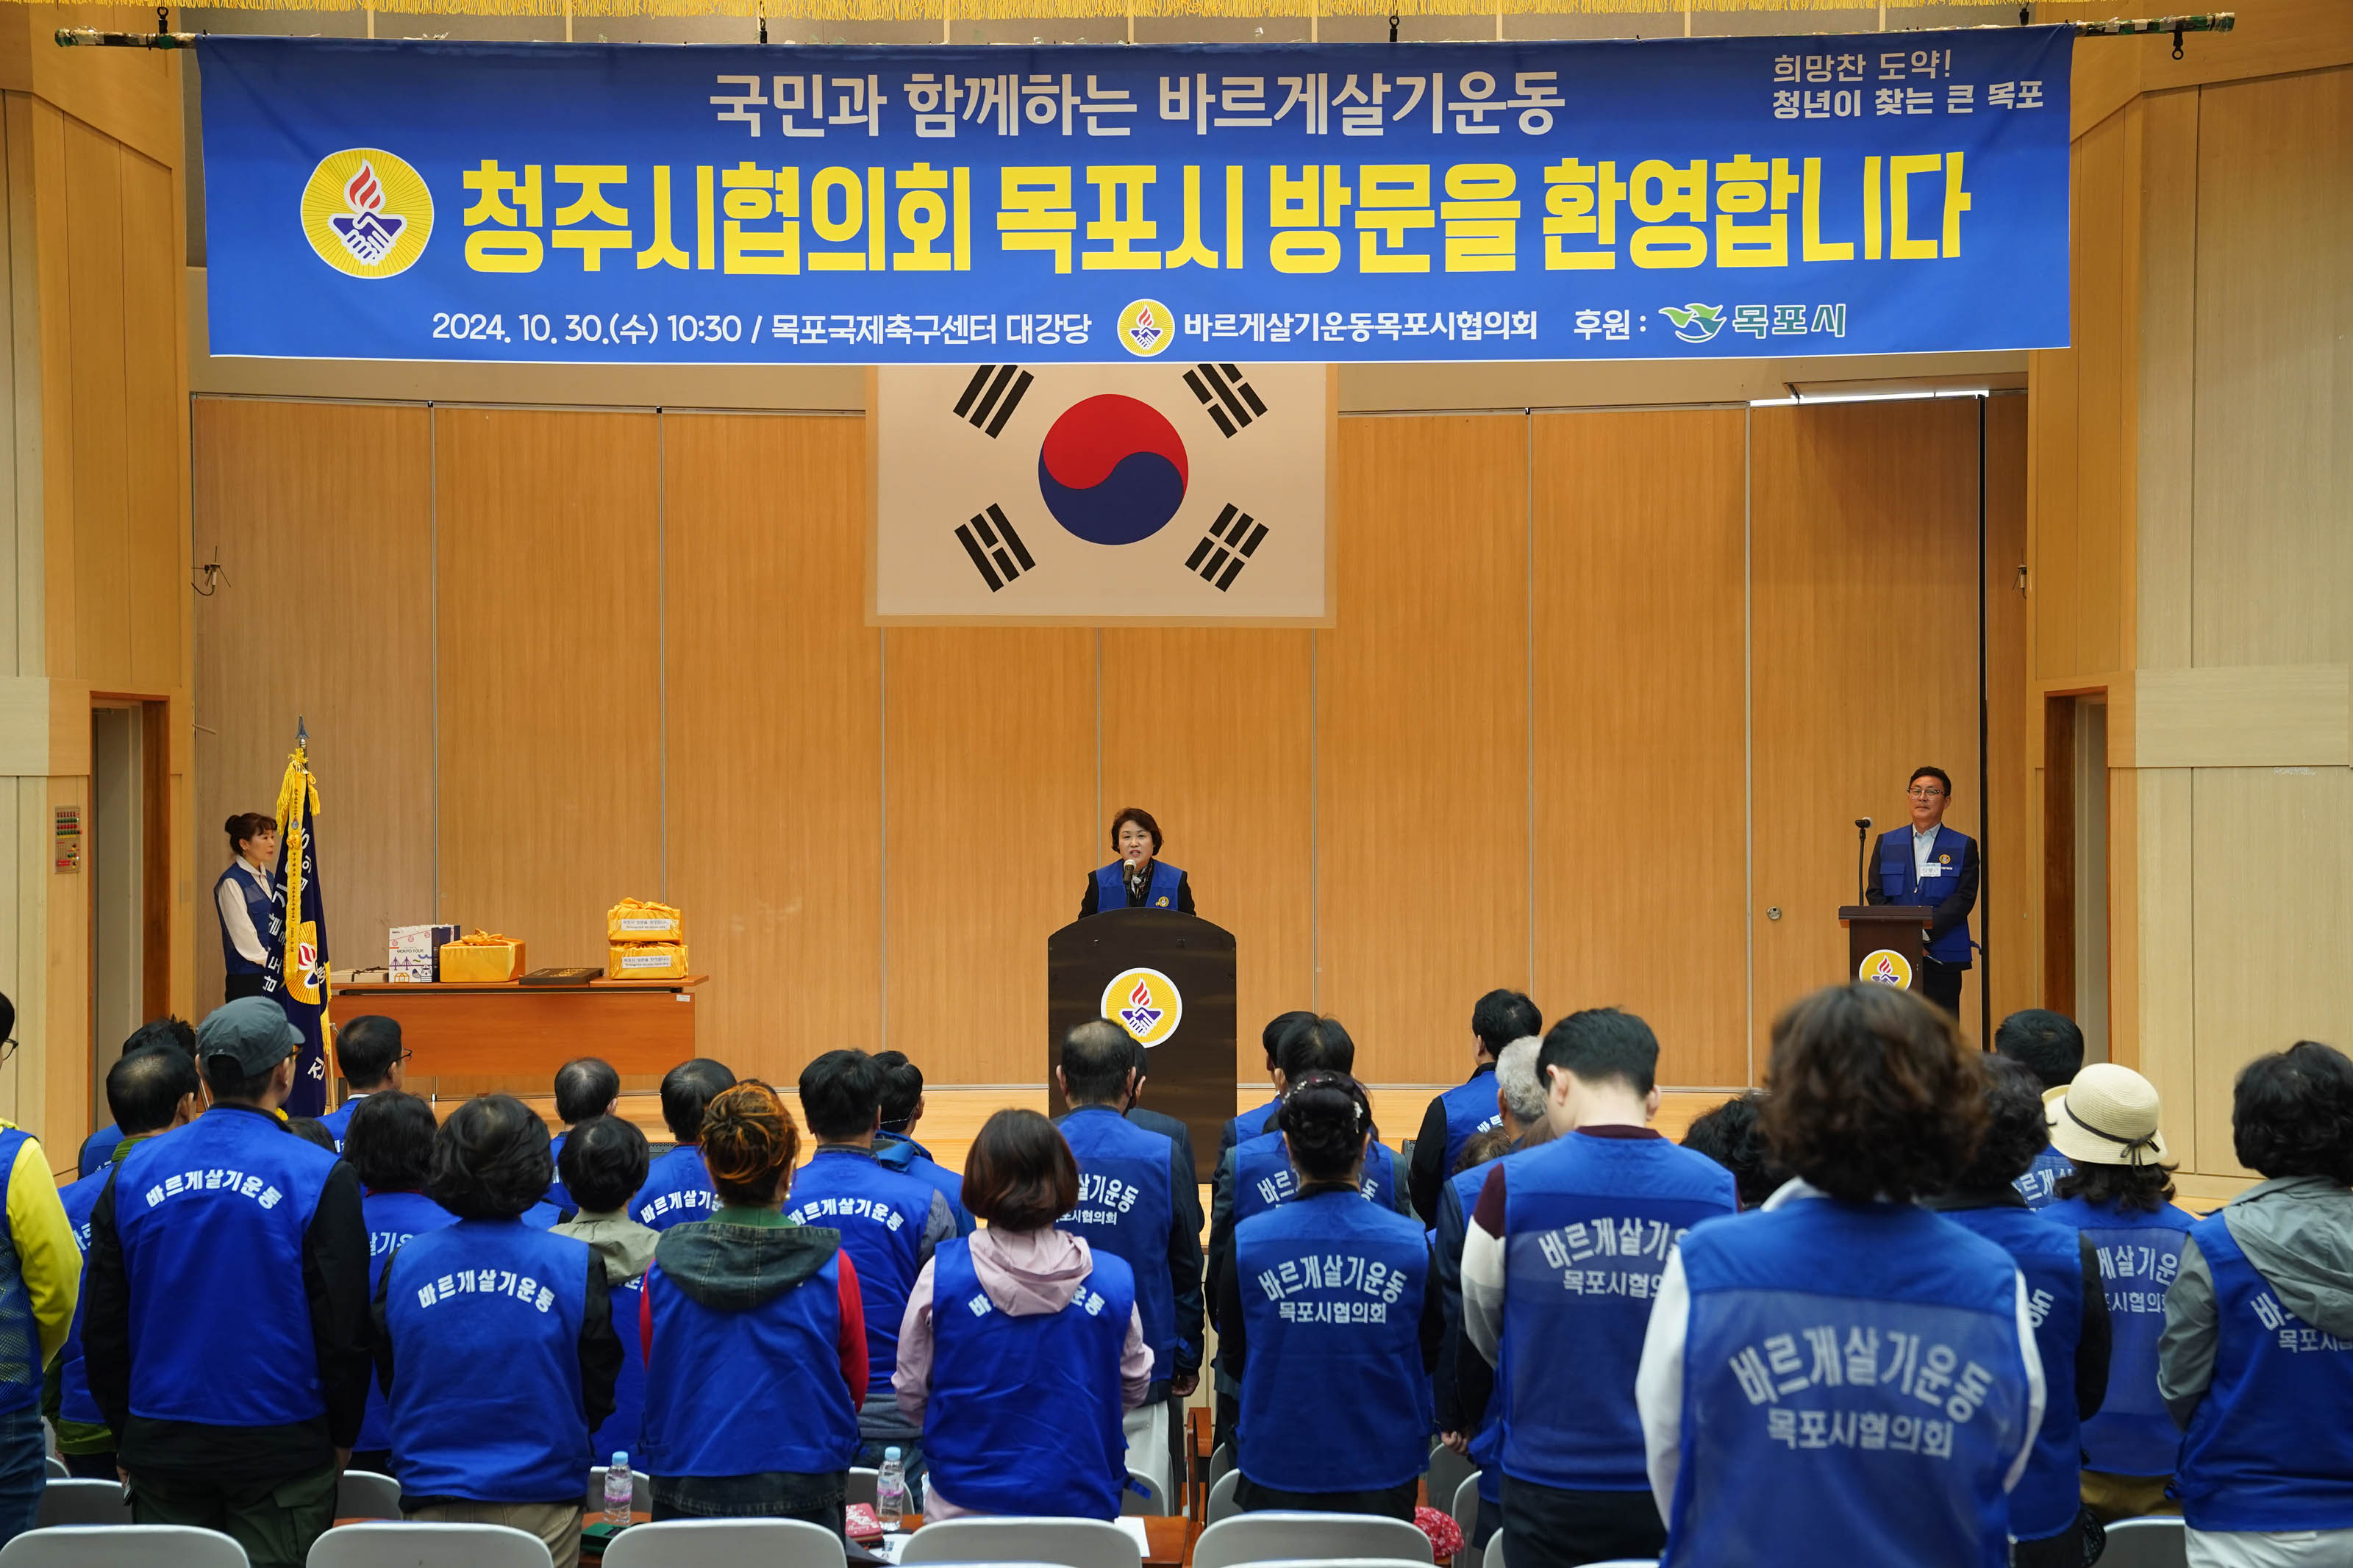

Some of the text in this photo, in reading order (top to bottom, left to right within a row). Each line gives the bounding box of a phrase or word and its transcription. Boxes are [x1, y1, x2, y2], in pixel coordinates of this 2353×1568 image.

[1774, 49, 1952, 82] 희망찬 도약!
[710, 71, 1565, 138] 국민과 함께하는 바르게살기운동
[1772, 80, 2044, 120] 청년이 찾는 큰 목포
[463, 151, 1972, 275] 청주시협의회 목포시 방문을 환영합니다
[432, 312, 512, 344] 2024.
[518, 313, 558, 345] 10.
[565, 312, 660, 345] 30.(수)
[666, 314, 743, 343] 10:30
[771, 312, 996, 346] 목포국제축구센터
[1006, 313, 1093, 346] 대강당
[1184, 310, 1538, 344] 바르게살기운동목포시협의회
[1573, 308, 1632, 341] 후원
[1732, 302, 1848, 340] 목포시
[146, 1169, 283, 1210] 바르게살기운동
[1077, 1173, 1139, 1214] 살기운동
[788, 1198, 904, 1232] 바르게살기운동
[417, 1269, 556, 1314] 바르게살기운동
[1257, 1254, 1408, 1305] 바르게살기운동
[1279, 1300, 1387, 1324] 목포시협의회
[1728, 1325, 1993, 1425] 바르게살기운동
[1767, 1407, 1954, 1461] 목포시협의회
